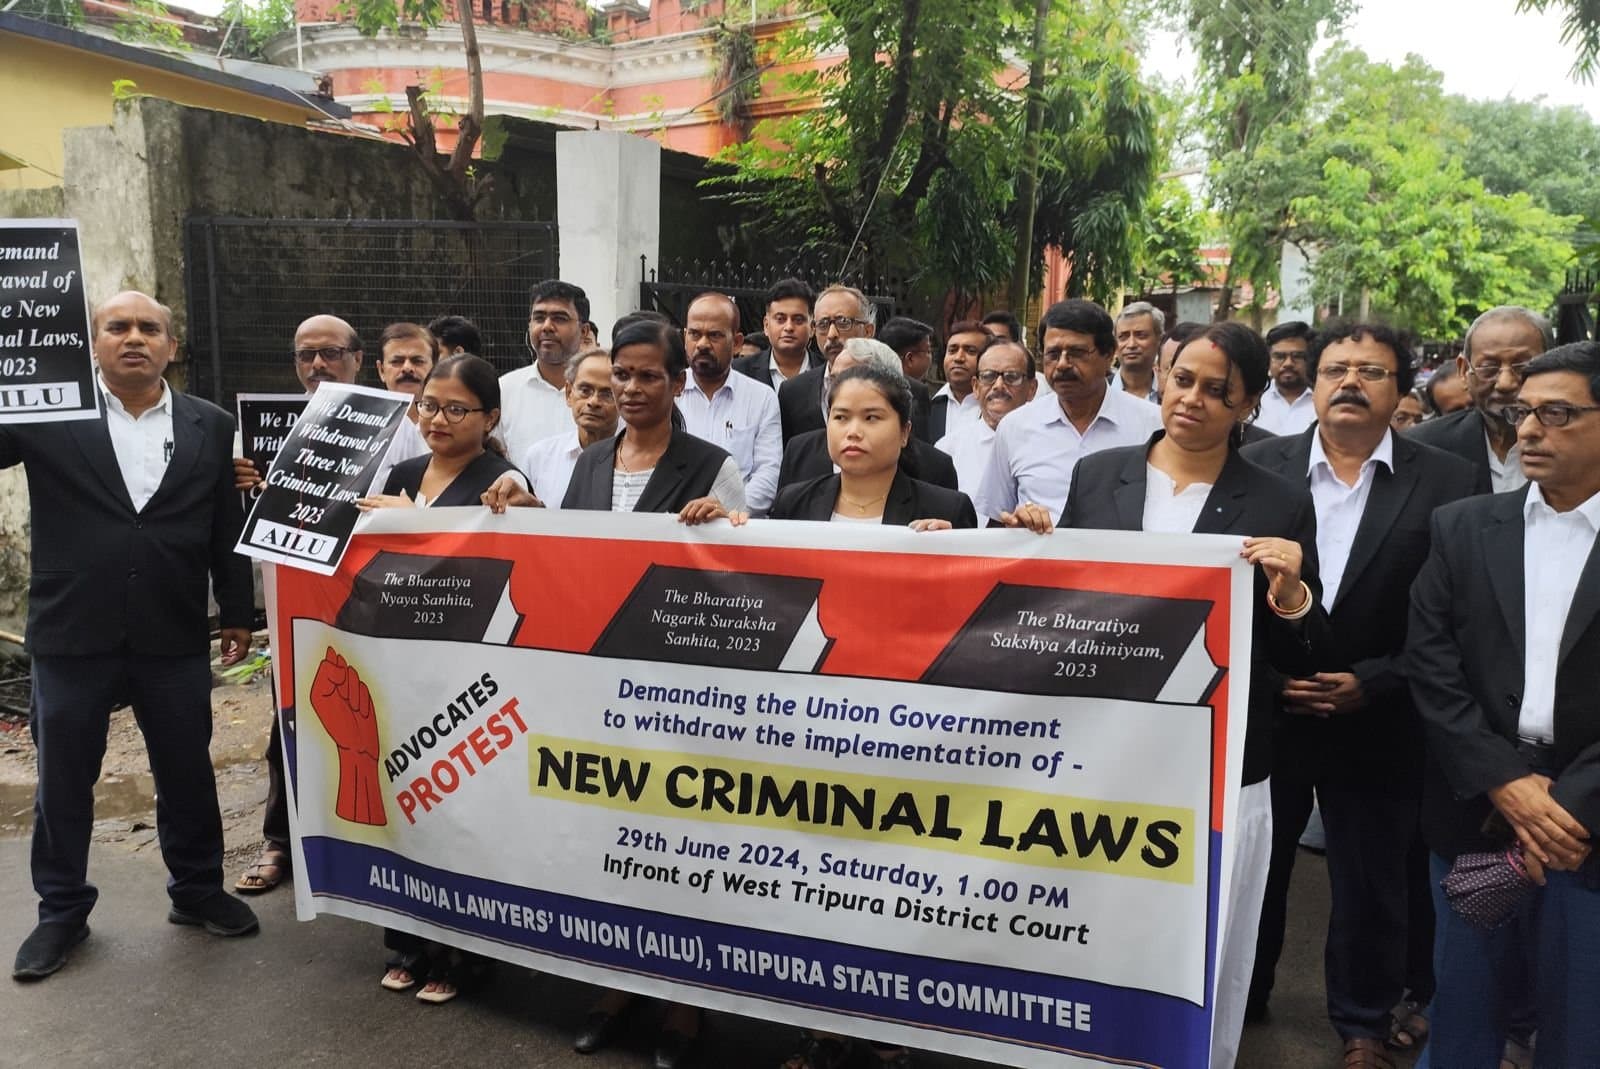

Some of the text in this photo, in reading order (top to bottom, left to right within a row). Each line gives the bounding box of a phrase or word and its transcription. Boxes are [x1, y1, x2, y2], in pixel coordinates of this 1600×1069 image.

[0, 242, 60, 260] emand
[53, 270, 76, 293] of
[17, 299, 60, 318] New
[29, 328, 84, 348] Laws,
[0, 357, 37, 376] 023
[2, 387, 65, 407] ILU
[260, 412, 281, 428] We
[320, 400, 393, 428] We Demand
[298, 423, 371, 451] Withdrawal
[369, 438, 389, 458] of
[294, 448, 335, 471] Three
[335, 457, 364, 476] New
[269, 469, 331, 498] Criminal
[289, 503, 325, 524] 2023
[261, 527, 327, 555] AILU
[383, 573, 471, 590] The Bharatiya
[380, 592, 474, 609] Nyaya Sanhita,
[664, 589, 763, 611] The Bharatiya
[413, 611, 444, 625] 2023
[651, 610, 776, 632] Nagarik Suraksha
[1017, 610, 1140, 637] The Bharatiya
[665, 632, 761, 652] Sanhita, 2023
[991, 632, 1165, 661] Sakshya Adhiniyam,
[1054, 662, 1097, 678] 2023
[618, 678, 1061, 740] Demanding the Union Government
[384, 672, 499, 783] ADVOCATES
[603, 709, 626, 729] to
[634, 711, 746, 741] withdraw
[756, 728, 795, 748] the
[804, 729, 1021, 769] implementation
[1032, 751, 1064, 778] of
[396, 697, 530, 825] PROTEST
[537, 747, 1182, 868] NEW CRIMINAL LAWS
[616, 826, 1070, 909] 29th June 2024, Saturday, 1.00 PM
[603, 854, 1090, 945] Infront of West Tripura District Court
[369, 865, 400, 893] ALL
[404, 874, 451, 910] INDIA
[559, 914, 630, 950] UNION
[636, 925, 712, 972] (AILU),
[718, 944, 826, 988] TRIPURA
[832, 964, 909, 1001] STATE
[917, 978, 1092, 1032] COMMITTEE
